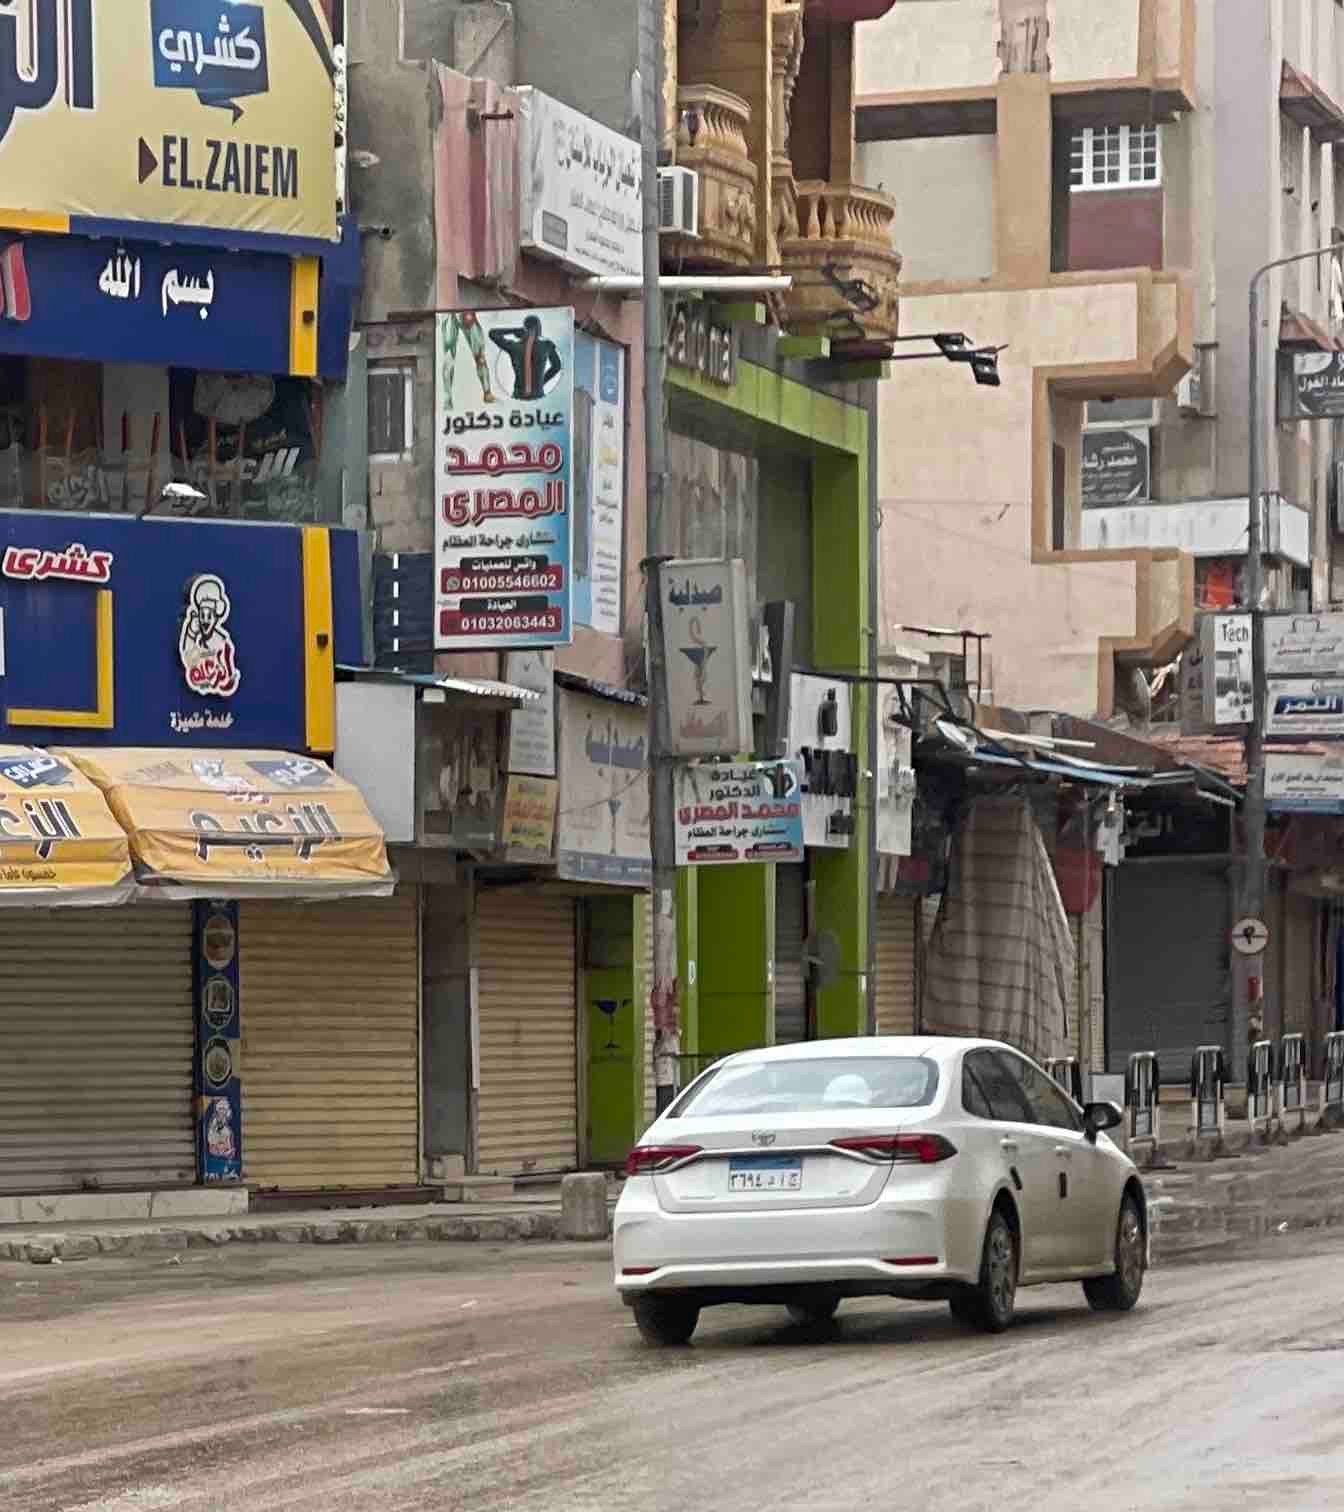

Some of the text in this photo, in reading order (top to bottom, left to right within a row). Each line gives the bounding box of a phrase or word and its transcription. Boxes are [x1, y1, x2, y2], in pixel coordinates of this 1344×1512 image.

[158, 16, 262, 75] كشري
[160, 134, 299, 199] EL.ZAIEM
[98, 242, 215, 320] بسم الله
[443, 409, 565, 435] عيادة دكتور
[446, 442, 564, 477] محمد
[479, 533, 514, 550] جراحة
[189, 801, 343, 864] الزعيم
[741, 802, 801, 819] محمد
